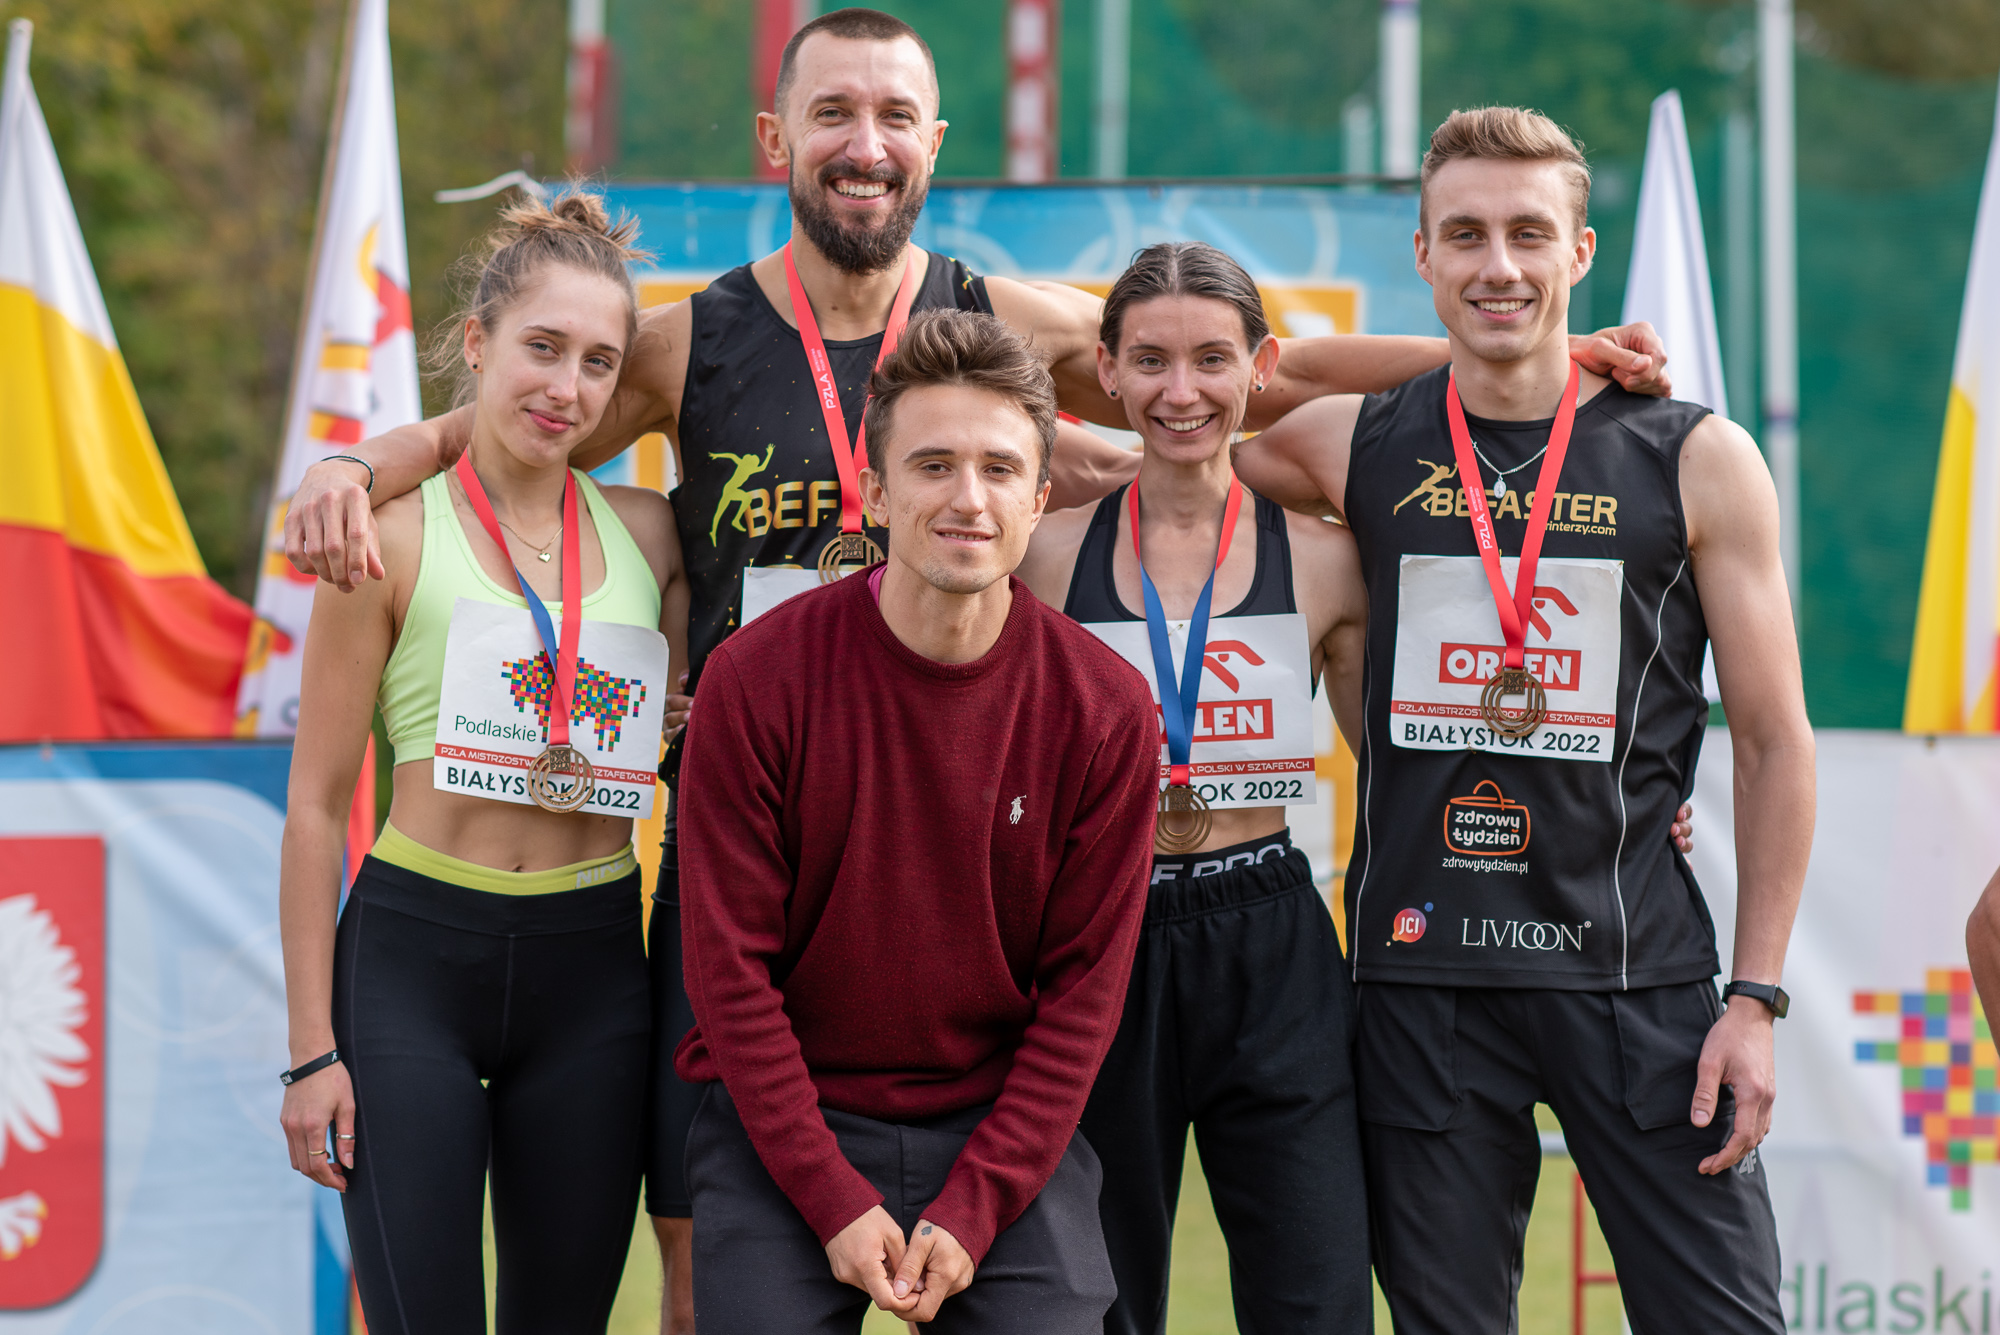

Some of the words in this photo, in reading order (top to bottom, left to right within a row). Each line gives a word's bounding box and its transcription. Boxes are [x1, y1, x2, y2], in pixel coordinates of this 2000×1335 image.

[819, 373, 836, 409] PZLA
[1476, 513, 1493, 549] PZLA
[1446, 648, 1572, 686] OREN
[1157, 705, 1265, 737] LEN
[1398, 703, 1426, 714] PZLA
[1427, 706, 1498, 718] MISTRZOST
[1549, 714, 1610, 725] SZTAFETACH
[455, 715, 537, 742] Podlaskie
[1542, 732, 1600, 753] 2022
[441, 746, 467, 758] PZLA
[468, 751, 542, 768] MISTRZOSTW
[1197, 764, 1233, 774] POLSKI
[1235, 763, 1245, 772] W
[1248, 761, 1310, 772] SZTAFETACH
[584, 786, 640, 810] 2022
[1243, 779, 1303, 800] 2022
[1455, 810, 1520, 829] zdrowy
[1442, 855, 1529, 875] zdrowytydzien.pl
[1398, 916, 1420, 936] JCI
[1781, 1262, 2000, 1335] dlaski
